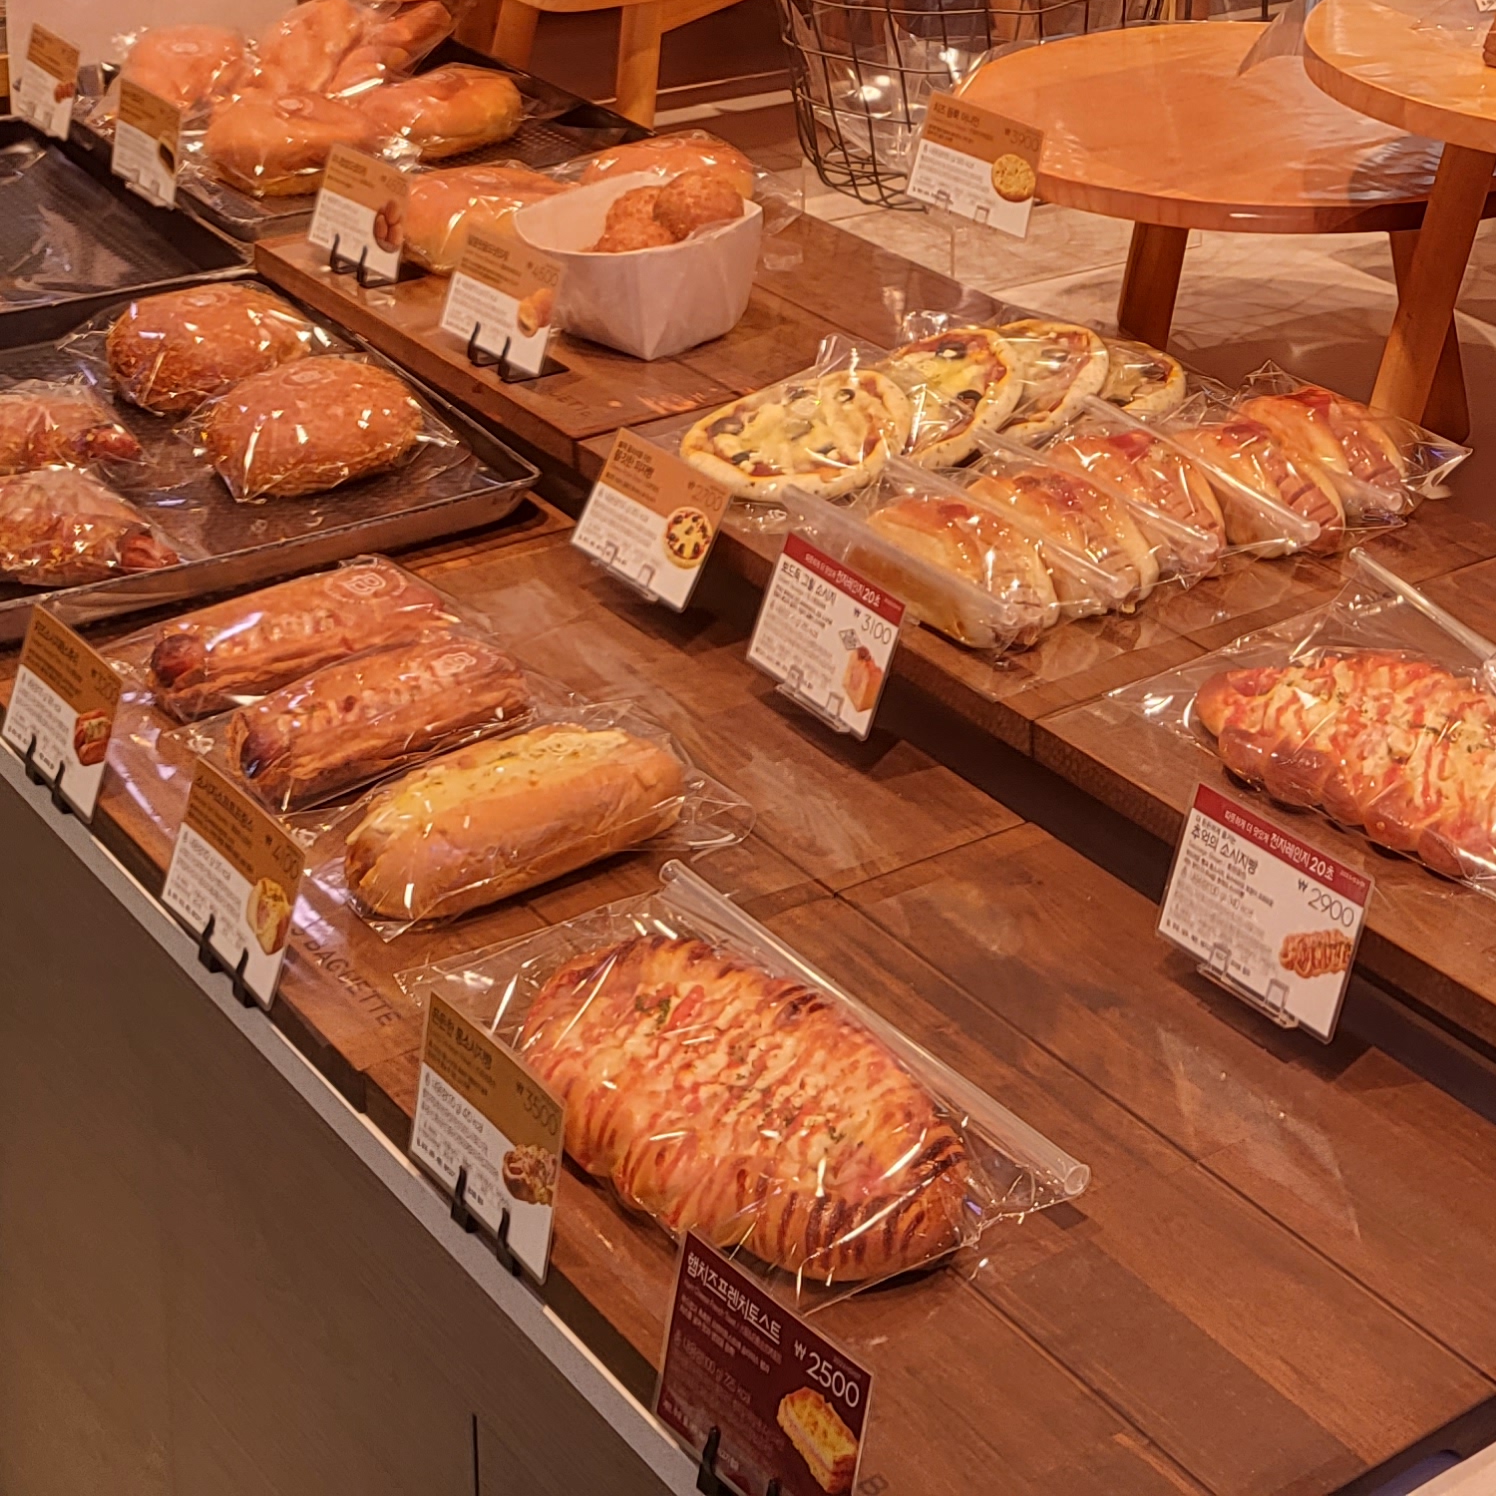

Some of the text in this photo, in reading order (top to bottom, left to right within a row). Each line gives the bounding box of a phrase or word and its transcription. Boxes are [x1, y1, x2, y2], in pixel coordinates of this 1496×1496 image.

[1189, 823, 1258, 876] 추억의 소시지빵
[1268, 832, 1310, 868] 전자레인지
[1308, 855, 1335, 882] 20초
[684, 1248, 783, 1345] 햄치즈프렌치토스트
